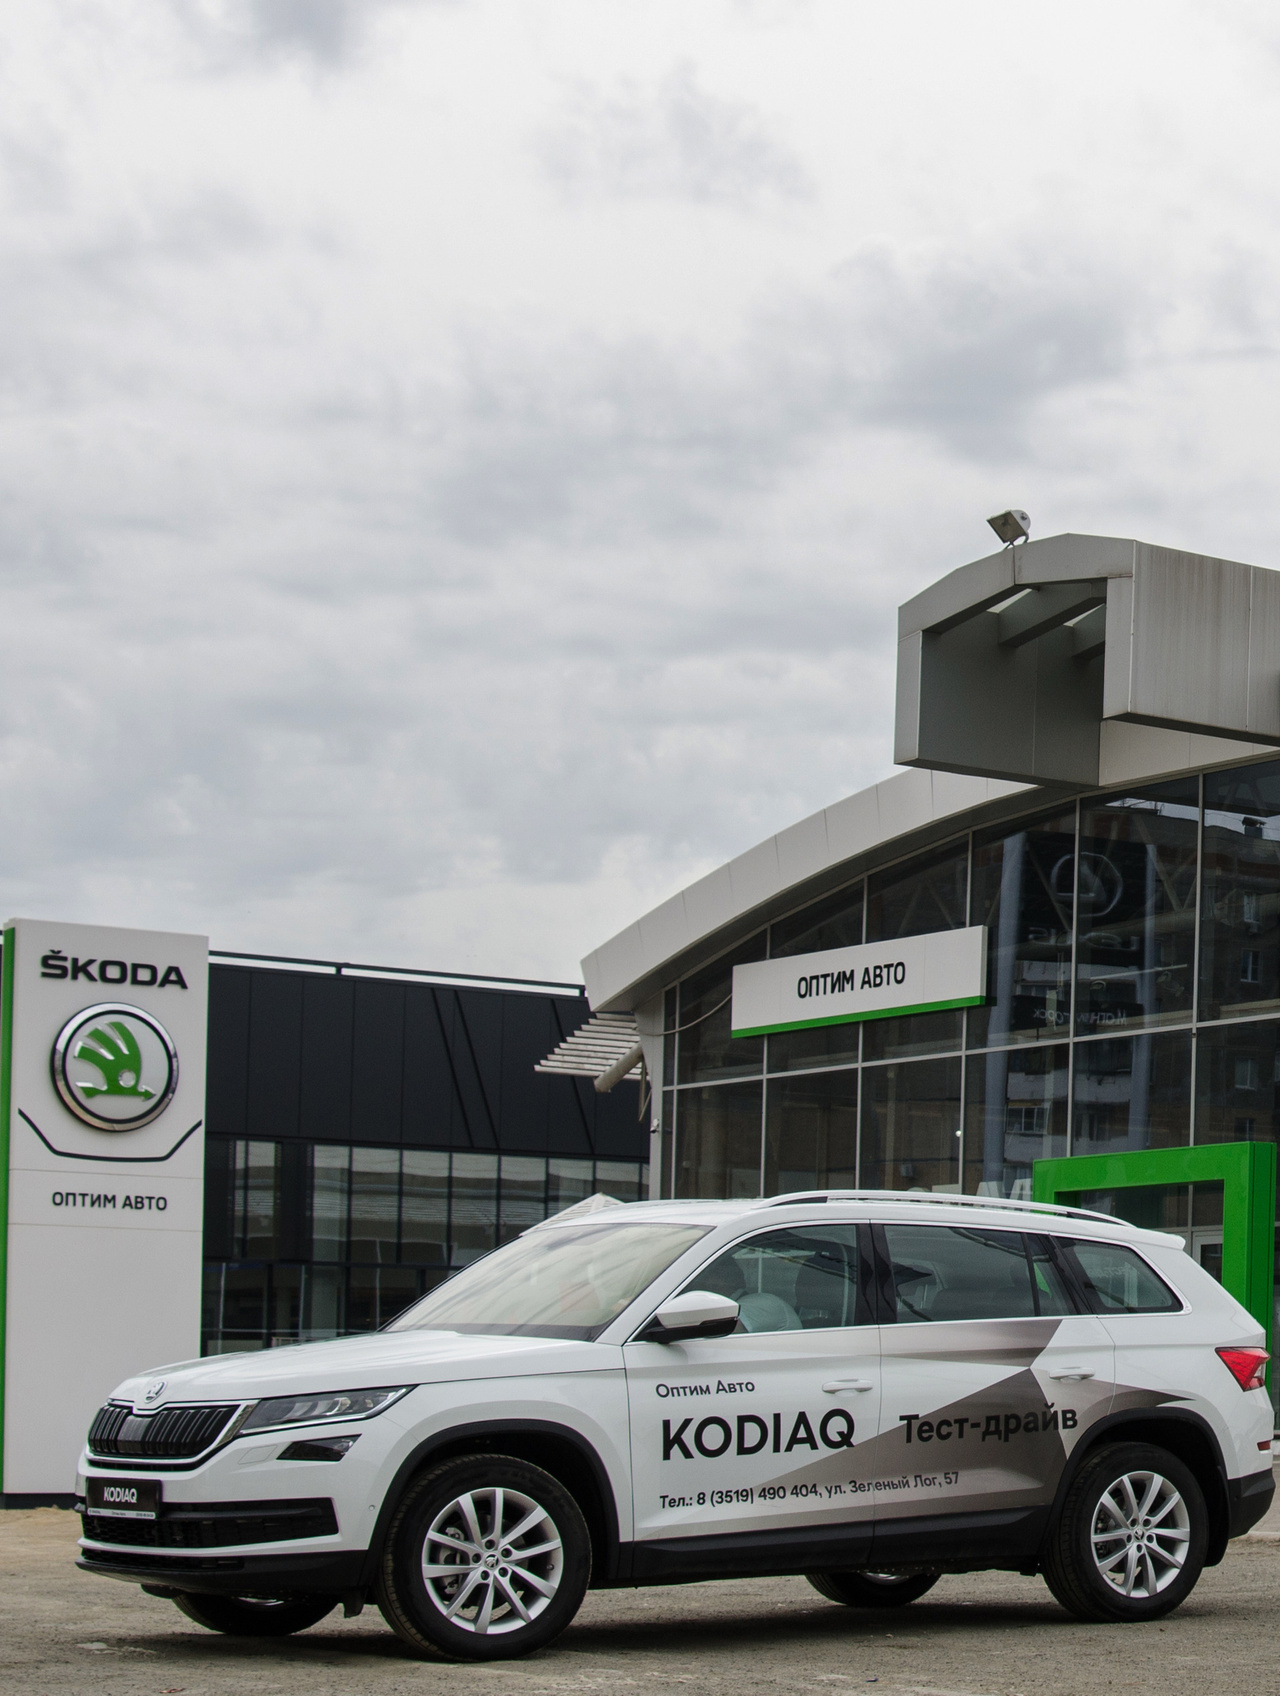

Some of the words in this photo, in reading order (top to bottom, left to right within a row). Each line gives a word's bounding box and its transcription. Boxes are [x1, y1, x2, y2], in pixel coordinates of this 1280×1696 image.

[40, 949, 188, 990] ŠKODA
[797, 969, 855, 999] ОПТИМ
[860, 961, 906, 990] АВТО
[52, 1191, 117, 1210] ОПТИМ
[121, 1195, 168, 1211] АВТО
[655, 1383, 711, 1398] Оптим
[715, 1379, 755, 1396] Авто
[661, 1407, 857, 1462] KODIAQ
[898, 1401, 1078, 1444] Тест-драйв
[104, 1487, 137, 1503] KODIAQ
[659, 1494, 693, 1509] Тел.:
[696, 1491, 706, 1506] 8
[710, 1487, 754, 1508] (3519)
[757, 1485, 787, 1501] 490
[790, 1483, 823, 1499] 404,
[824, 1484, 847, 1499] ул.
[848, 1475, 911, 1494] Зеленый
[913, 1473, 942, 1489] Лог,
[943, 1471, 960, 1486] 57
